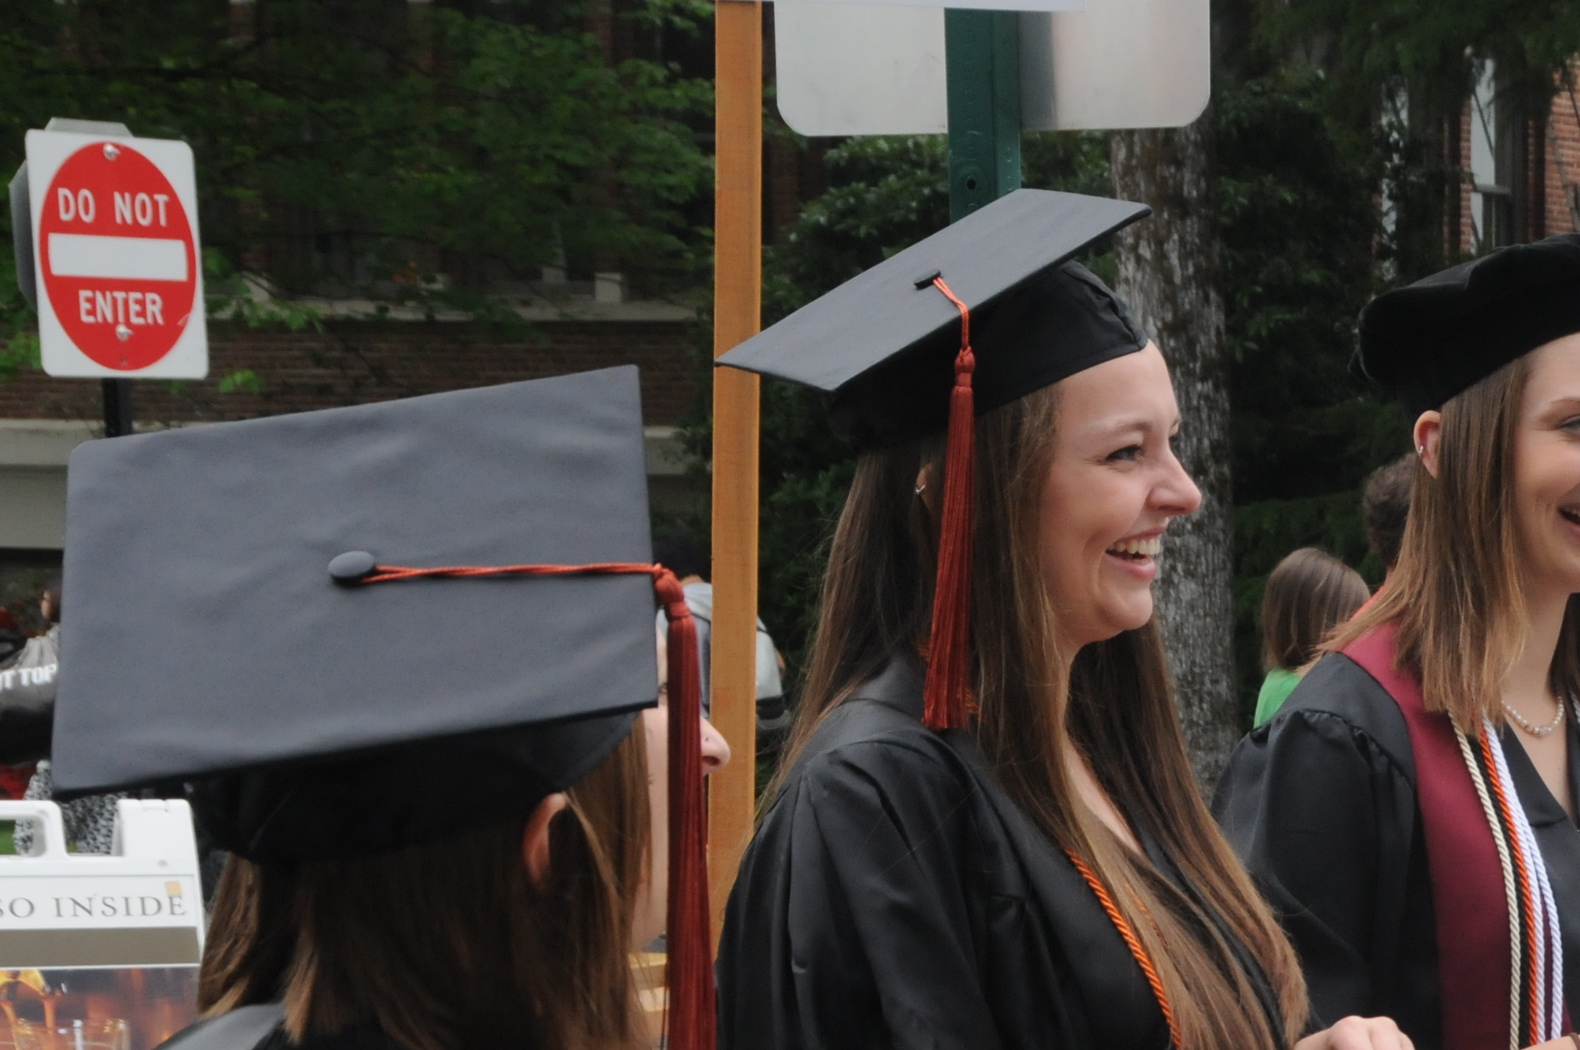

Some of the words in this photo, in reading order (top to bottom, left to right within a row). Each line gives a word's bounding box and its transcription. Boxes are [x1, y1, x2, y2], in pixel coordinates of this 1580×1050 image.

[57, 187, 96, 223] DO
[113, 191, 169, 227] NOT
[78, 290, 164, 325] ENTER
[0, 669, 16, 690] T
[0, 896, 35, 918] O
[52, 895, 187, 918] INSIDE
